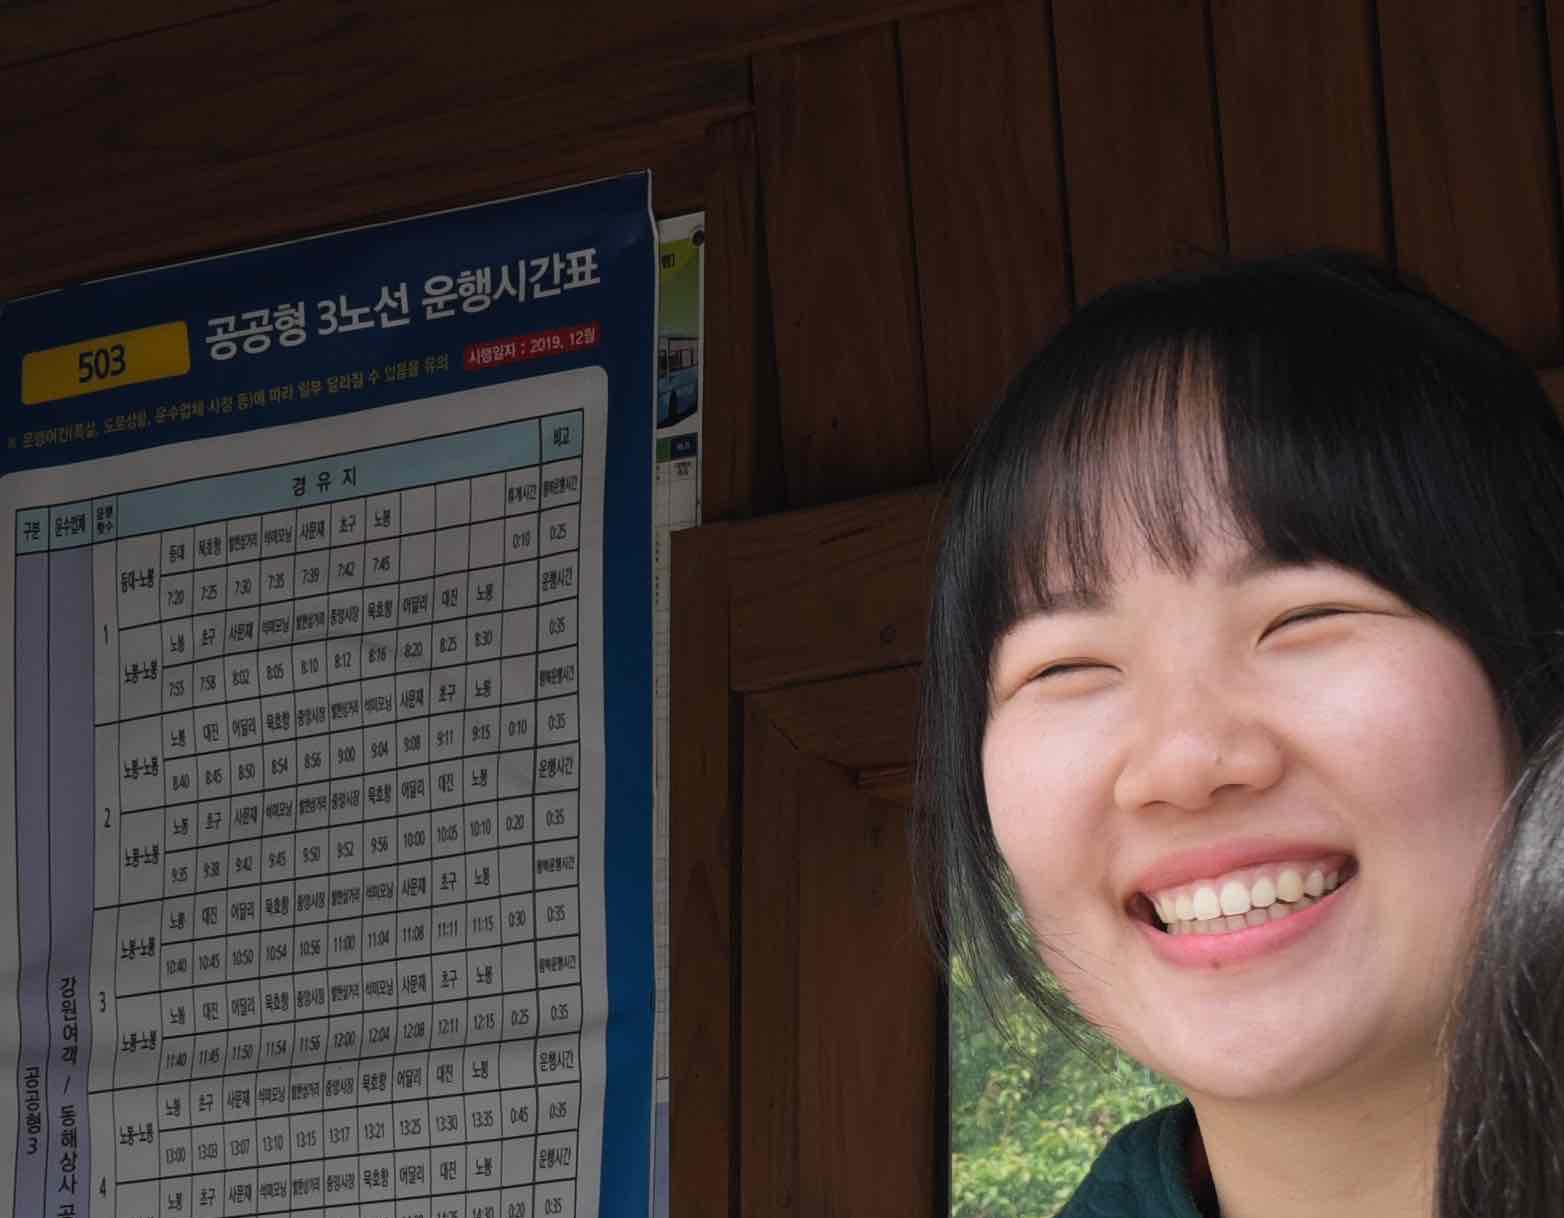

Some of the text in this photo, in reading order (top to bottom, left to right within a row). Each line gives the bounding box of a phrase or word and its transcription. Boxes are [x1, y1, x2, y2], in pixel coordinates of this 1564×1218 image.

[206, 248, 600, 360] 공공형 3노선 운행시간표
[569, 327, 596, 346] 12월
[78, 344, 126, 383] 503
[104, 625, 108, 645] 1
[104, 808, 111, 828] 2
[100, 991, 105, 1012] 3
[100, 1176, 106, 1197] 4
